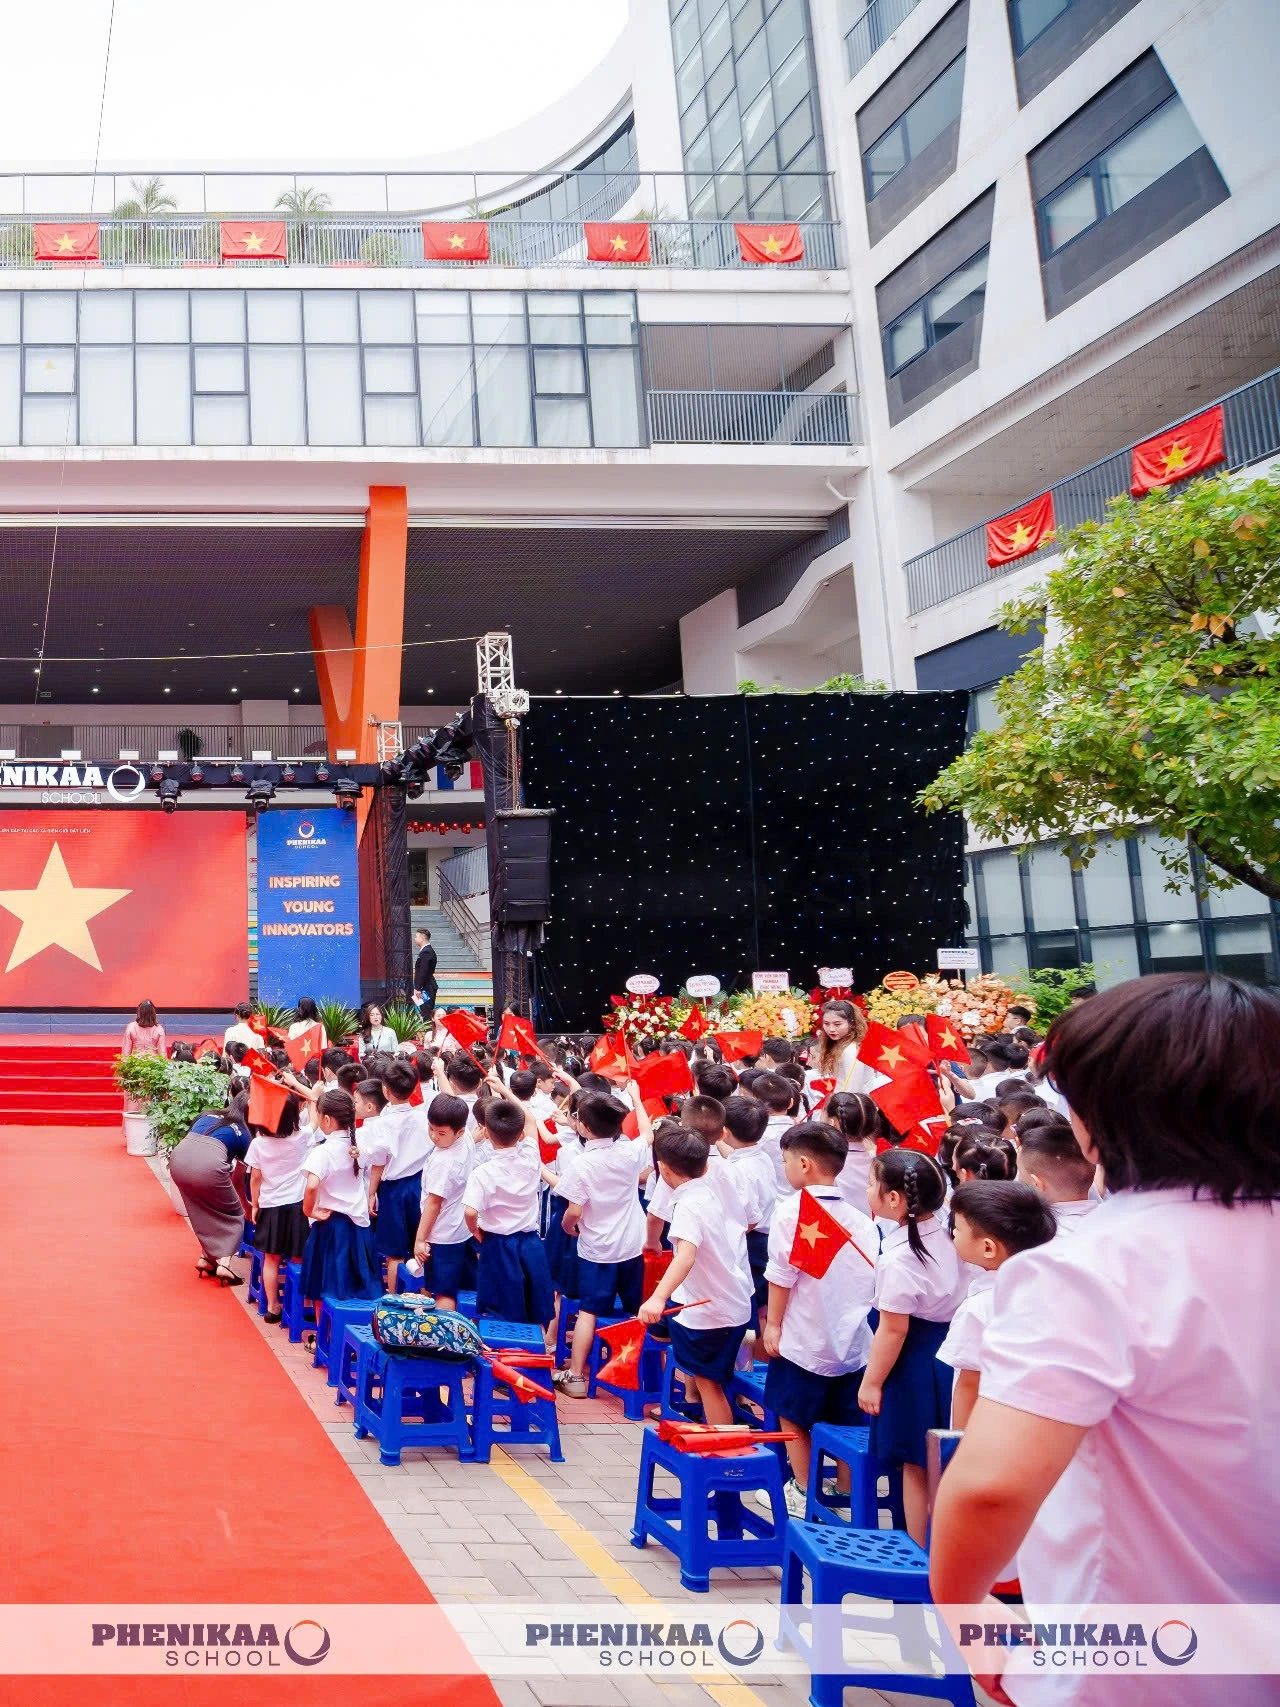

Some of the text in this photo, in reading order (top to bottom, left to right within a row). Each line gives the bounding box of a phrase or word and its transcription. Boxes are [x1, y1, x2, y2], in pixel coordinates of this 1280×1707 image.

[40, 791, 102, 804] SCHOOL
[269, 875, 340, 888] INSPIRING
[283, 900, 335, 913] YOUNG
[263, 923, 354, 936] INNOVATORS
